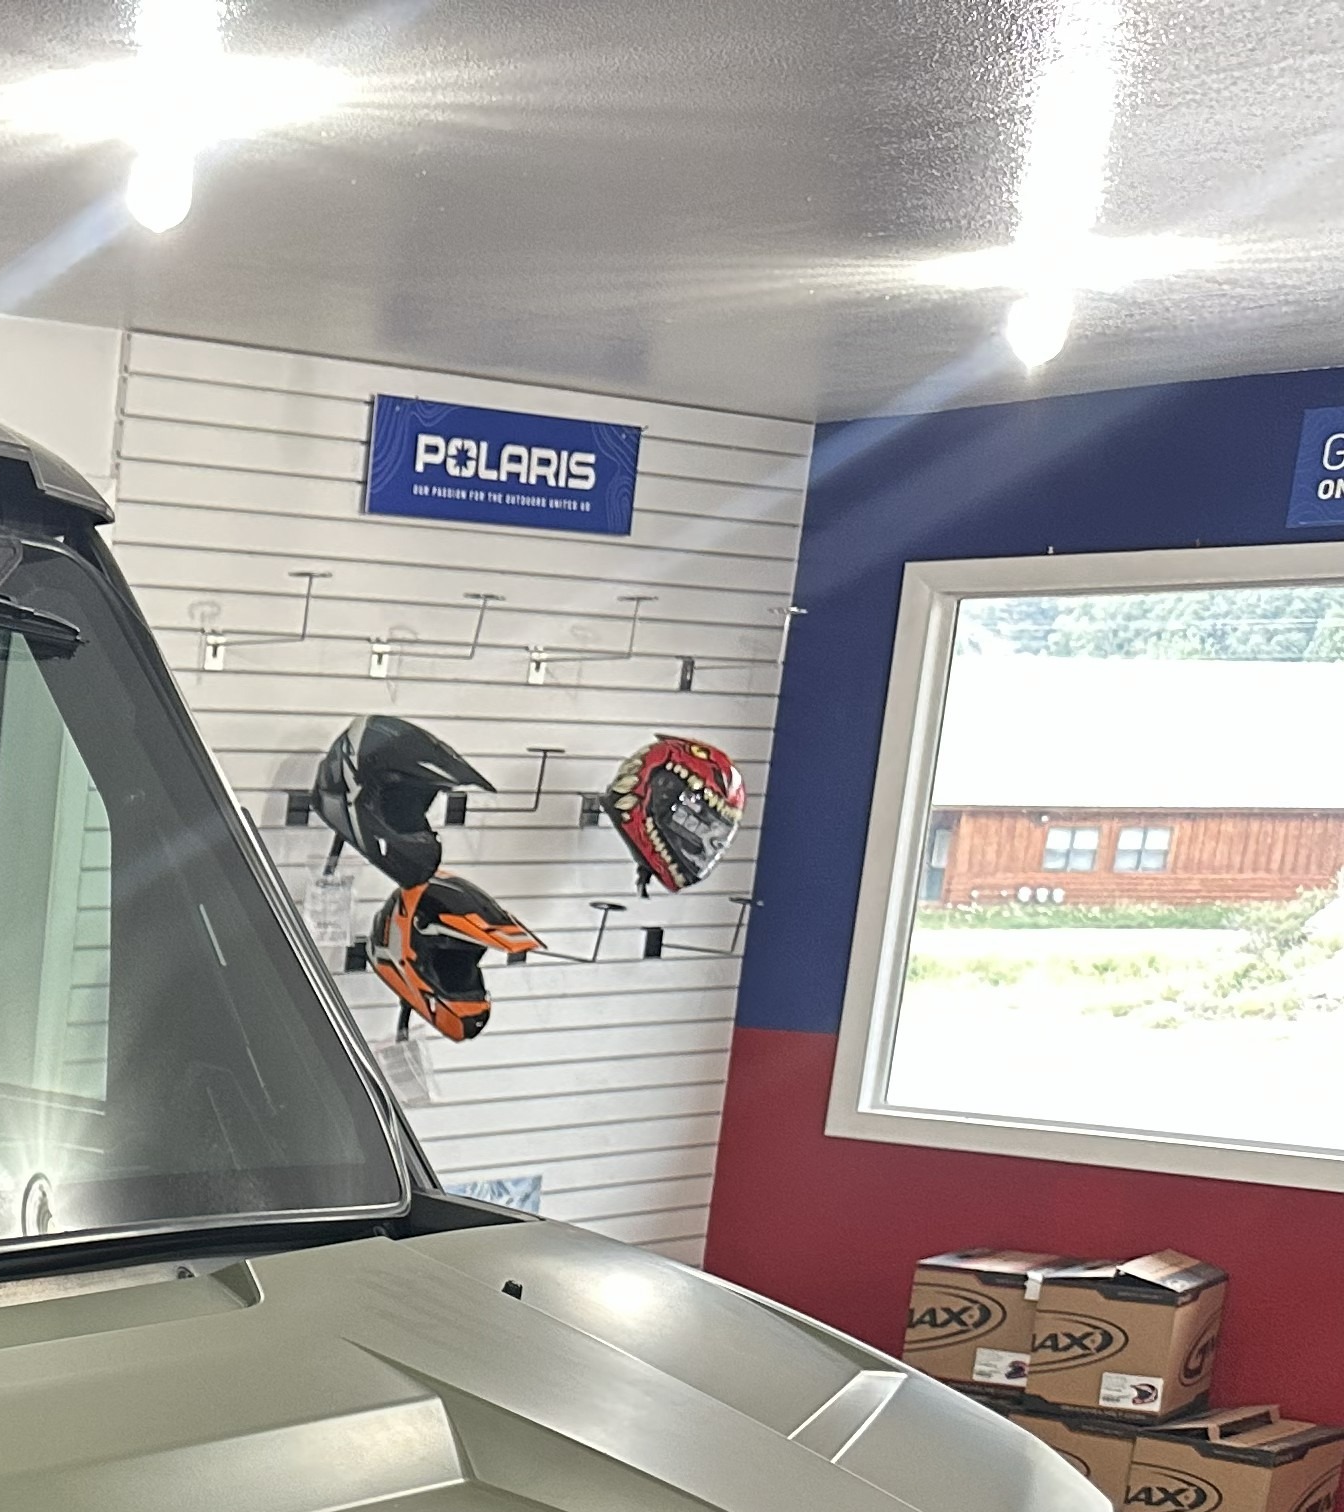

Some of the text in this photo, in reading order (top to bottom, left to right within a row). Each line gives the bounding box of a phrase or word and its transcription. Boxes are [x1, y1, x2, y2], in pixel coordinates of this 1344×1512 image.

[415, 433, 596, 491] POLARIS
[413, 484, 429, 496] OUR
[432, 485, 467, 500] PASSION
[469, 489, 485, 502] FOR
[488, 491, 503, 505] THE
